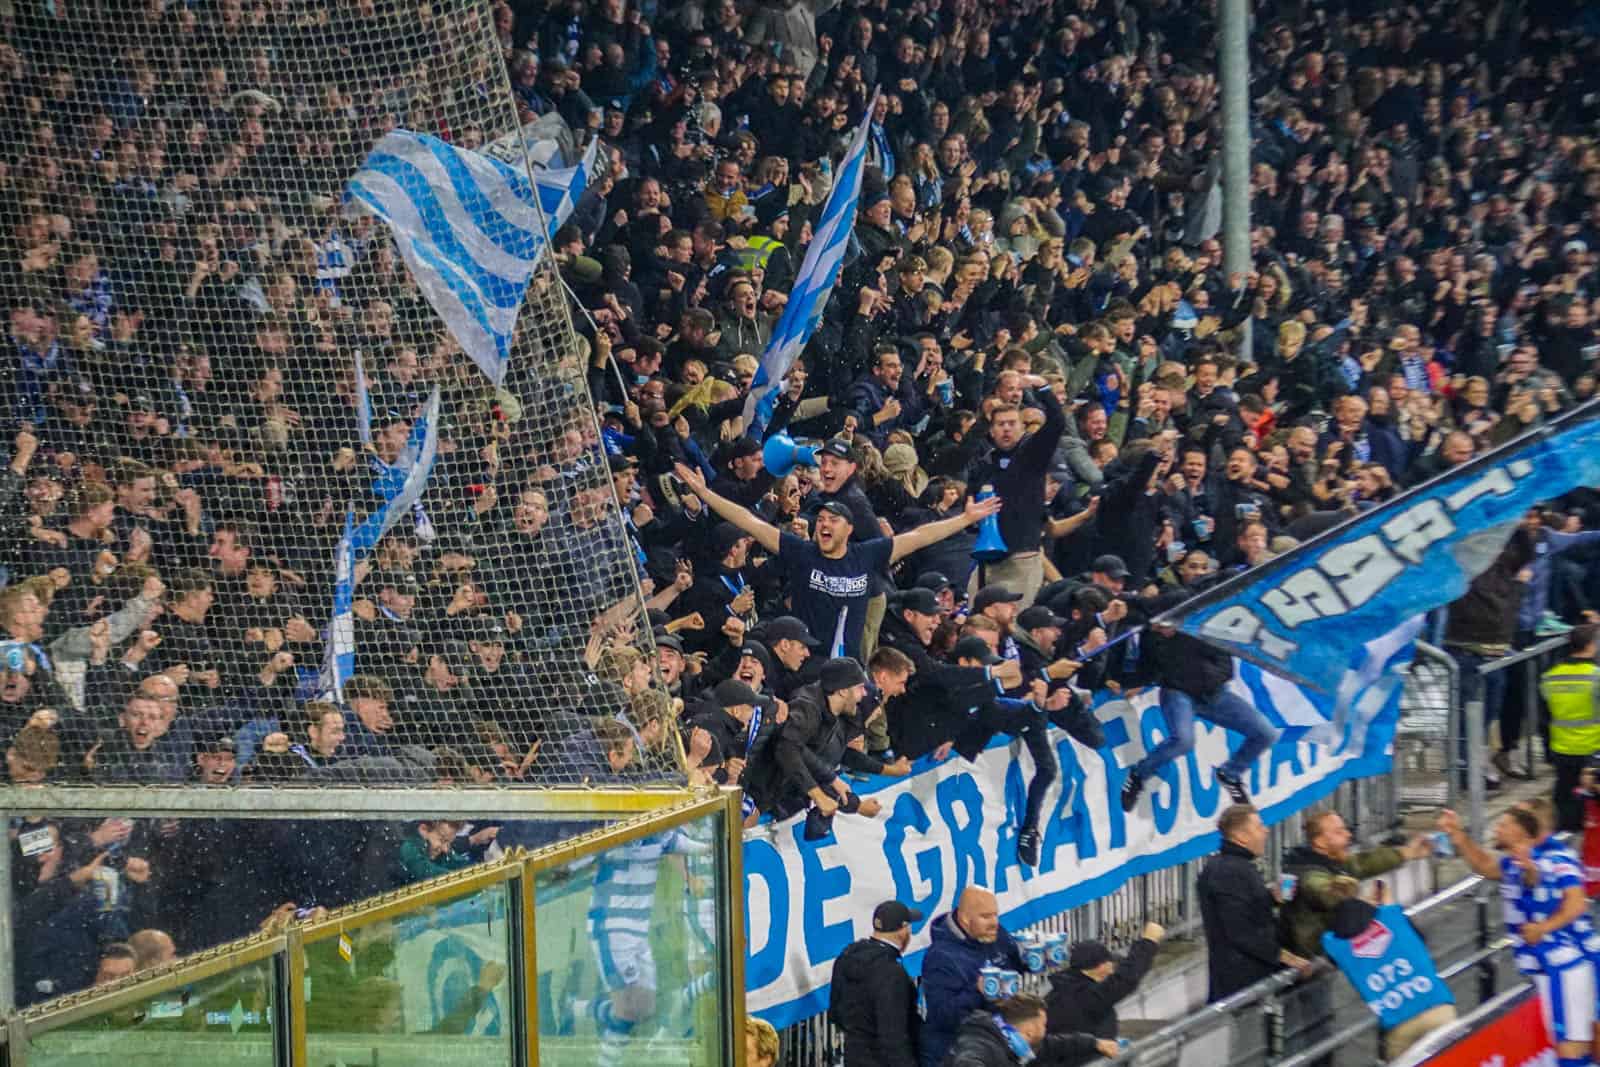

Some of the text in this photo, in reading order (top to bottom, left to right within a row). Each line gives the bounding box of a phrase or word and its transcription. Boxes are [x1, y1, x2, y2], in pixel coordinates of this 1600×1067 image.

[743, 820, 855, 992] DE
[1366, 957, 1414, 992] 073
[1367, 975, 1433, 1017] FOTO
